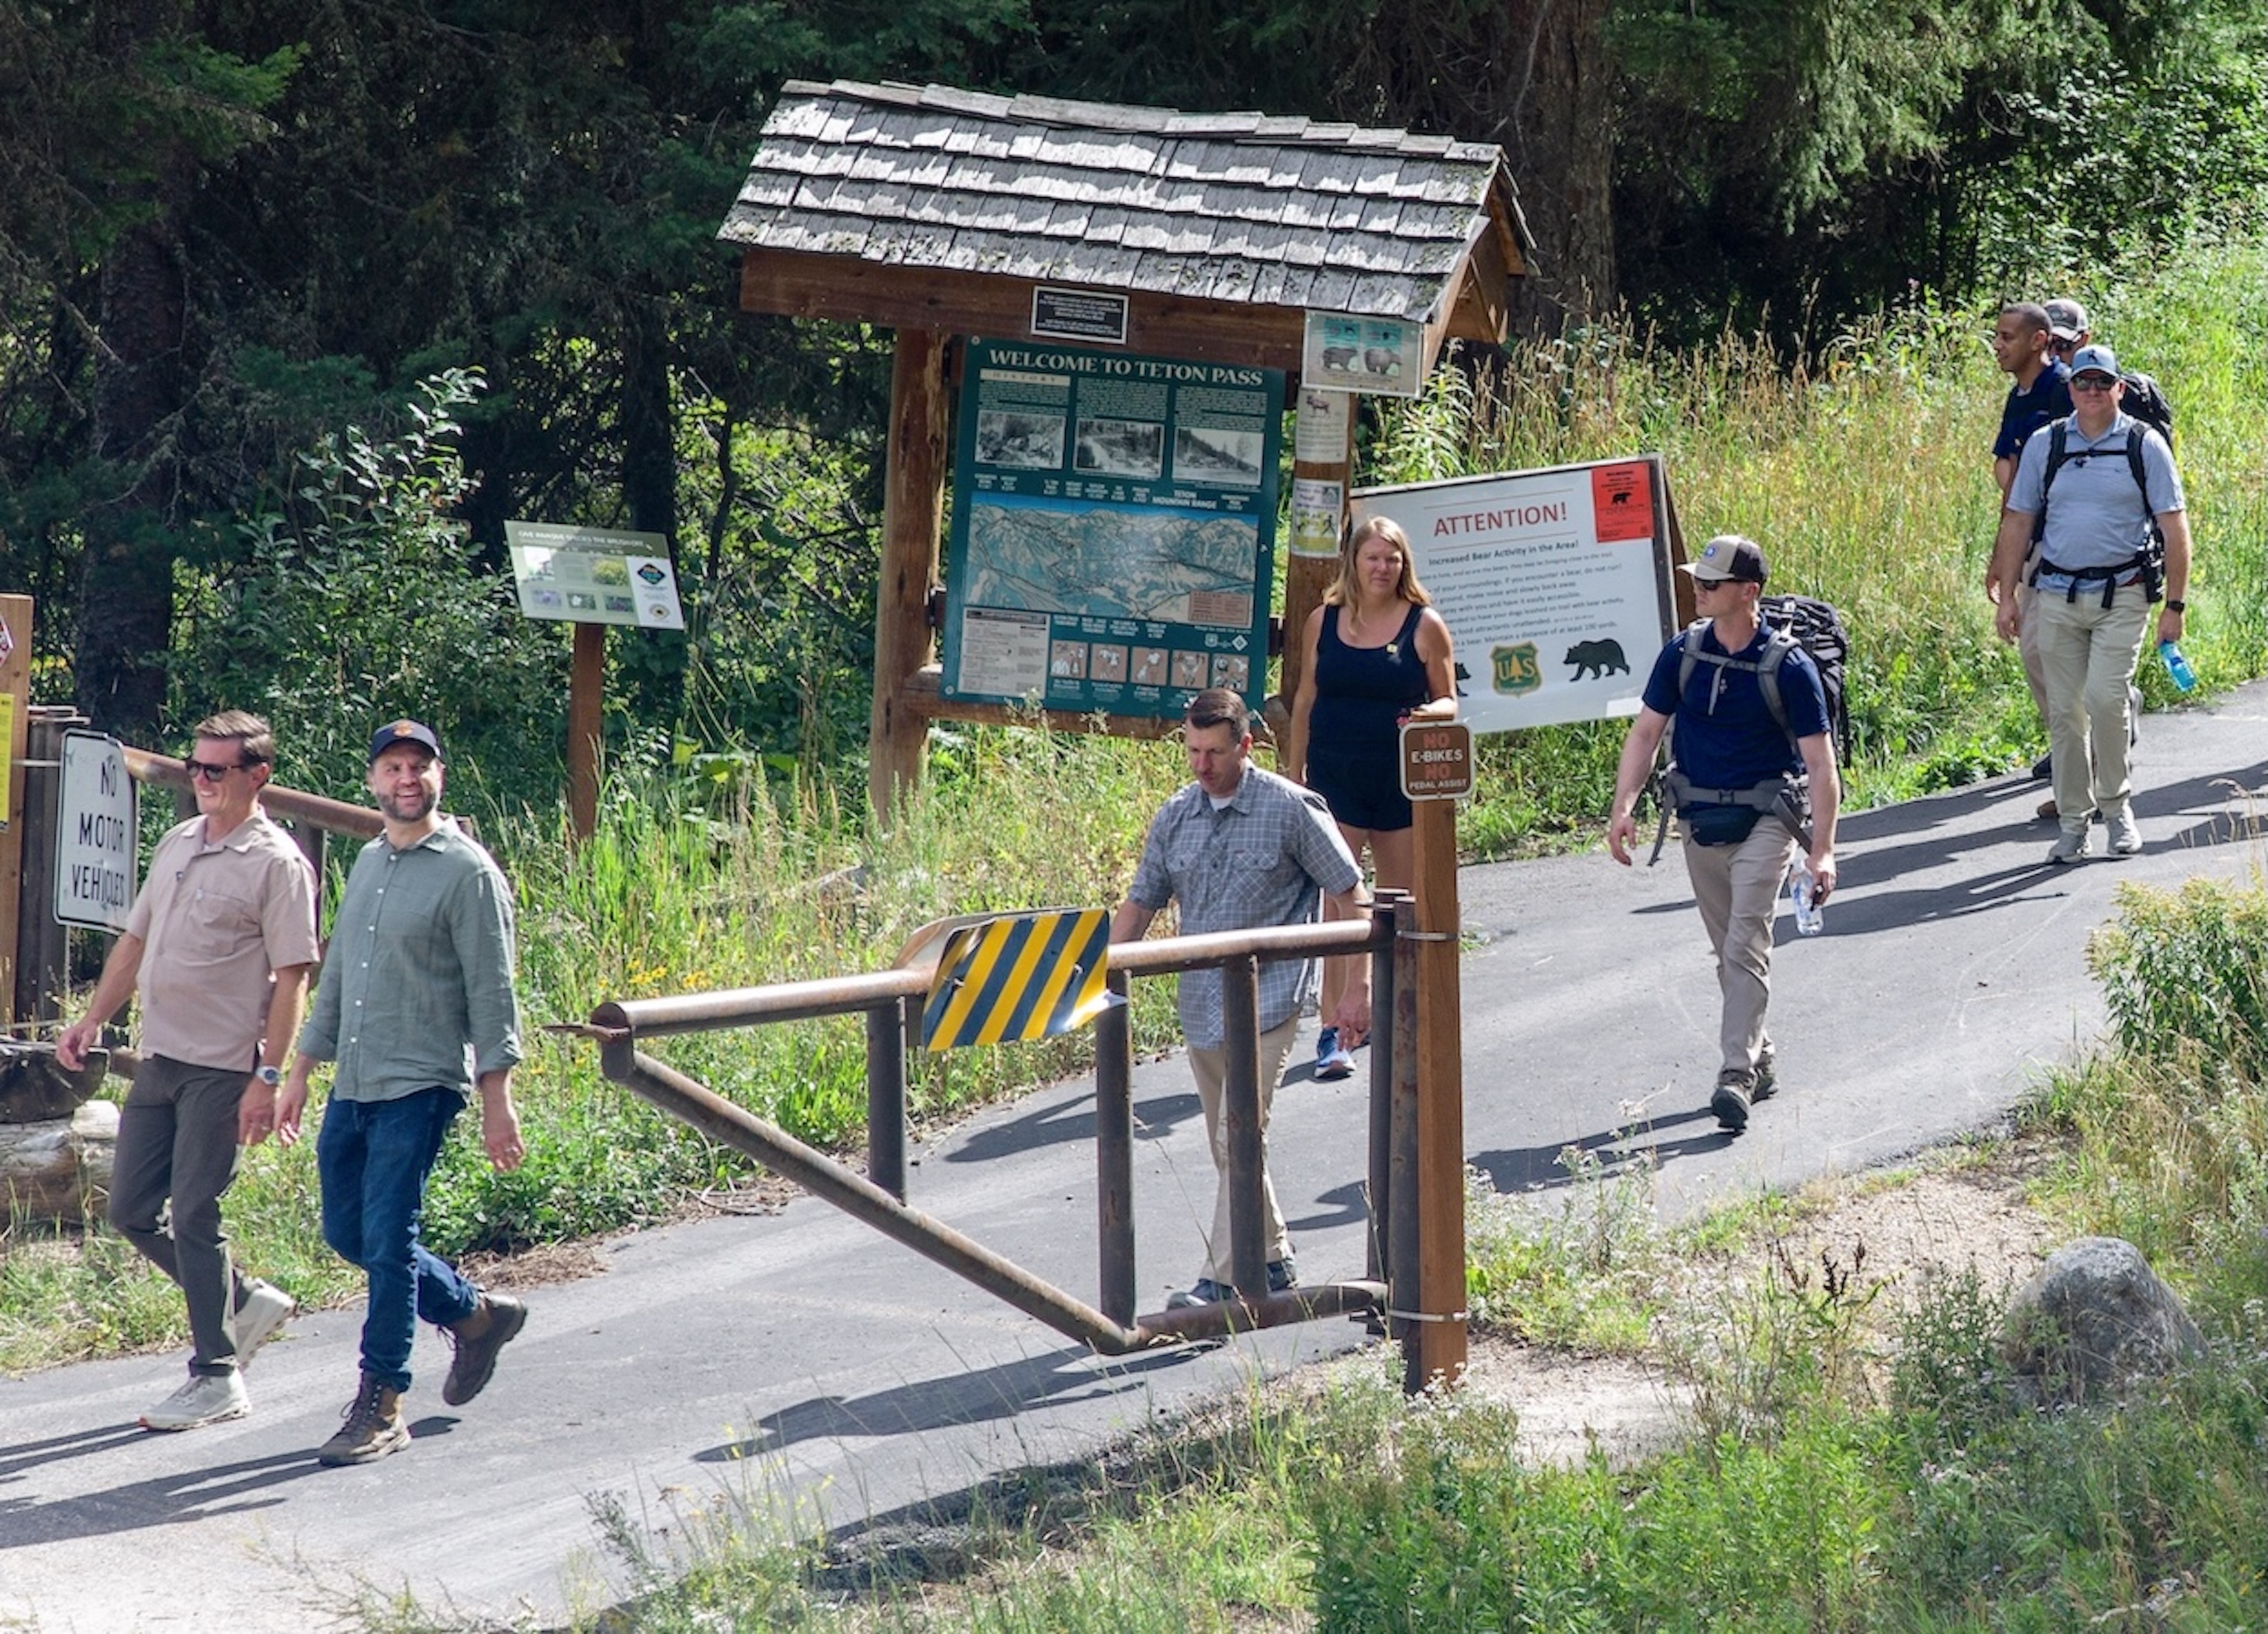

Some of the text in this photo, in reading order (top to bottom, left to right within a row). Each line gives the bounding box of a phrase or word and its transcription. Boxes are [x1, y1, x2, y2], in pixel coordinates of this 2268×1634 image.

[989, 349, 1264, 386] WELCOME TO TETON PASS
[992, 372, 1056, 382] HISTORY
[1174, 489, 1197, 499] TETON
[1153, 496, 1190, 506] MOUNTAIN
[1191, 500, 1216, 510] RANGE
[1434, 501, 1566, 537] ATTENTION!
[1429, 554, 1469, 565] Increased
[1472, 551, 1491, 560] Bear
[1494, 547, 1525, 559] Activity
[1538, 543, 1552, 552] the
[1556, 540, 1578, 549] Area!
[1423, 732, 1449, 748] NO
[1411, 748, 1463, 764] E-BIKES
[101, 761, 116, 797] NO
[1425, 763, 1451, 780] NO
[1409, 780, 1437, 790] PEDAL
[79, 812, 124, 852] MOTOR
[72, 863, 124, 907] VEHICLES
